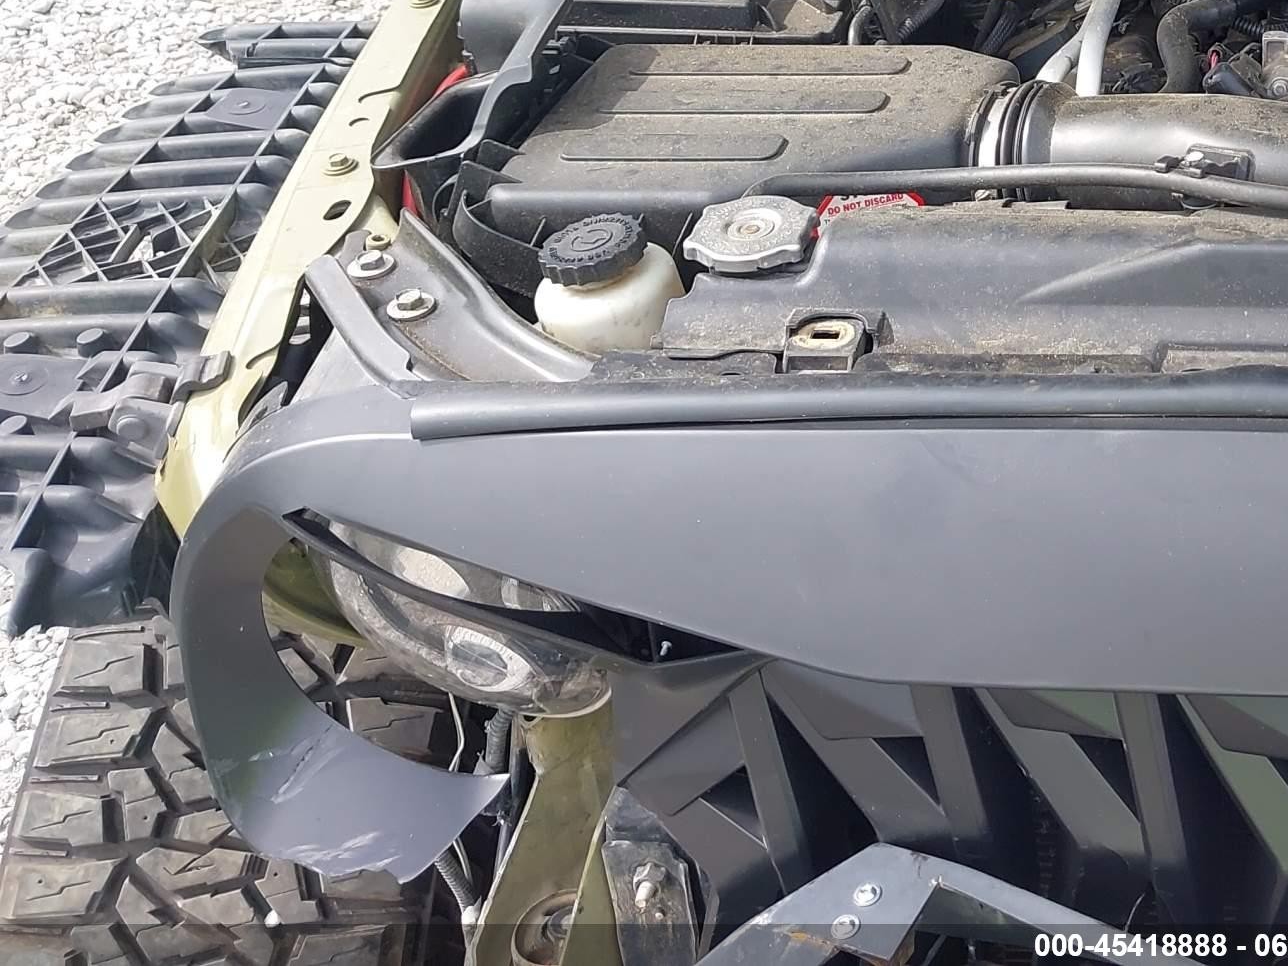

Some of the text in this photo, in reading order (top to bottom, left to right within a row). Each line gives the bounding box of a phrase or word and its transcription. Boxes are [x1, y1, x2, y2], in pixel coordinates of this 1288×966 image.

[827, 206, 841, 215] DO
[843, 201, 861, 212] NOT
[864, 193, 904, 207] DISCARD
